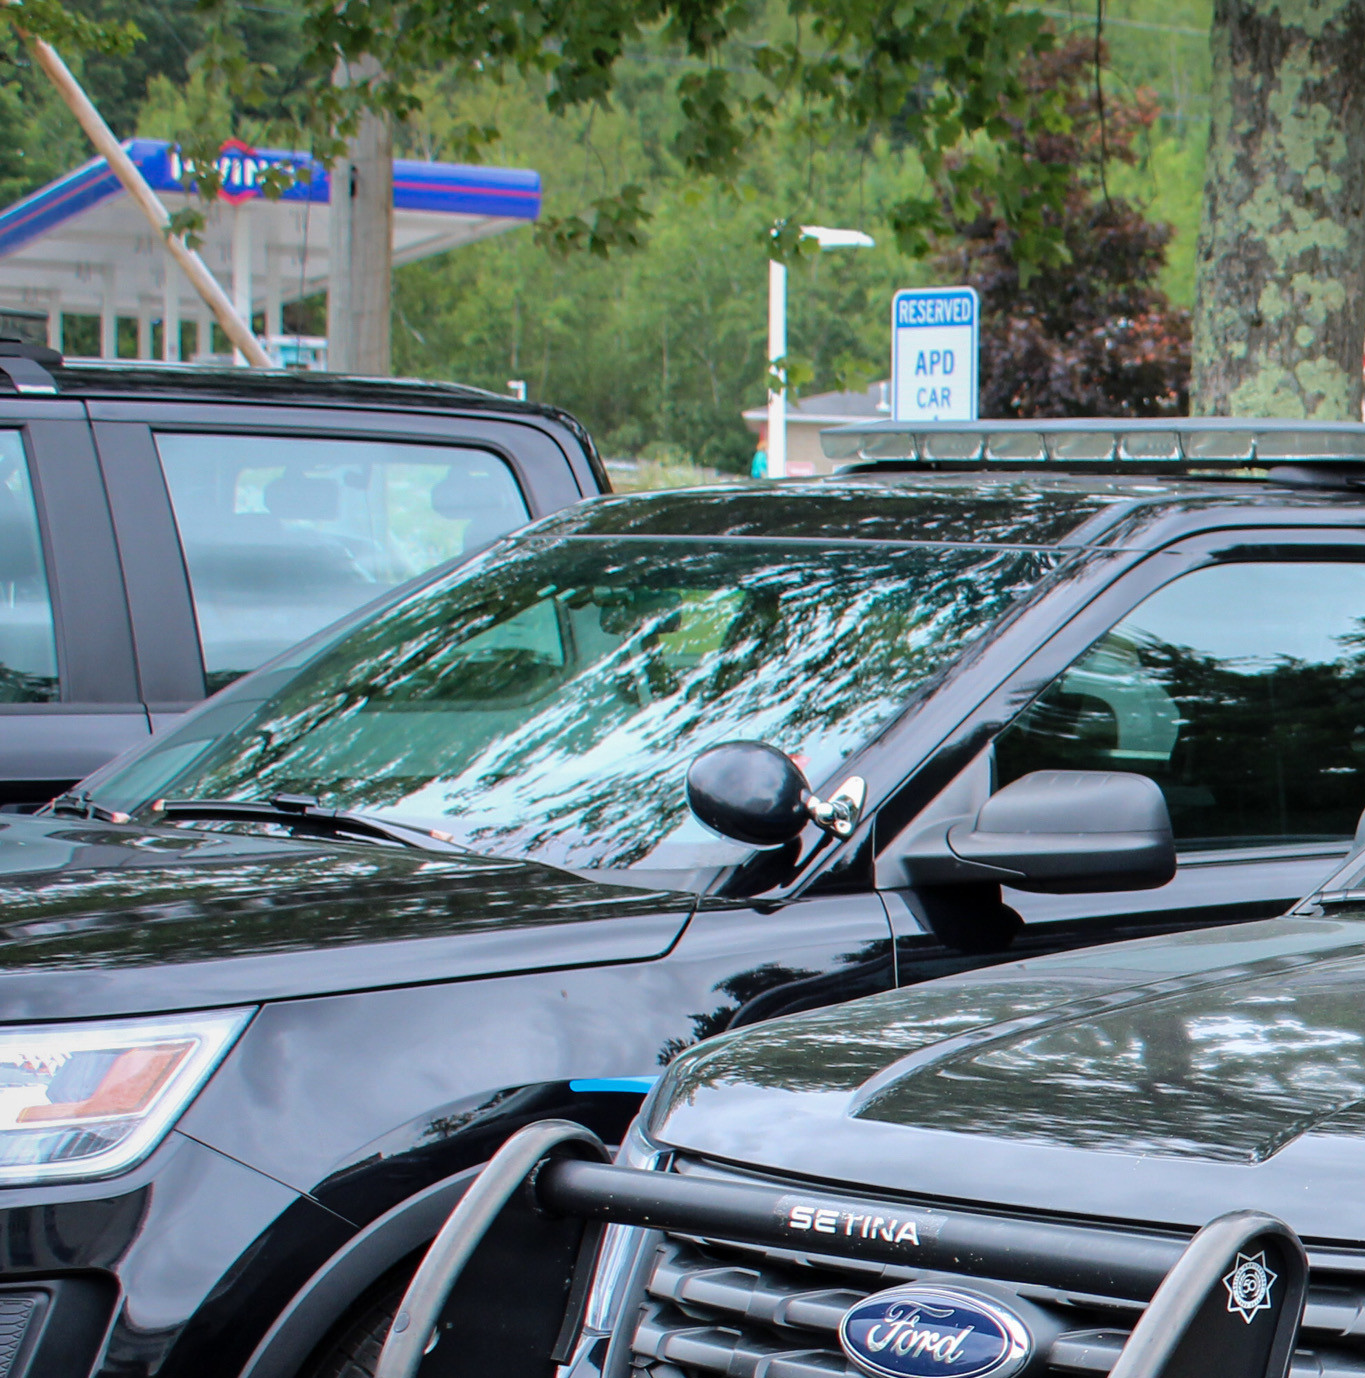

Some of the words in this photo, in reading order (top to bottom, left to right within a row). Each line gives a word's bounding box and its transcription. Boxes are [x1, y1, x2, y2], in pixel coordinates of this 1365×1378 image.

[898, 297, 972, 324] RESERVED
[915, 350, 955, 376] APD
[916, 387, 951, 408] CAR
[789, 1205, 920, 1246] SETINA
[1242, 1278, 1257, 1294] 50
[867, 1300, 975, 1363] Ford
